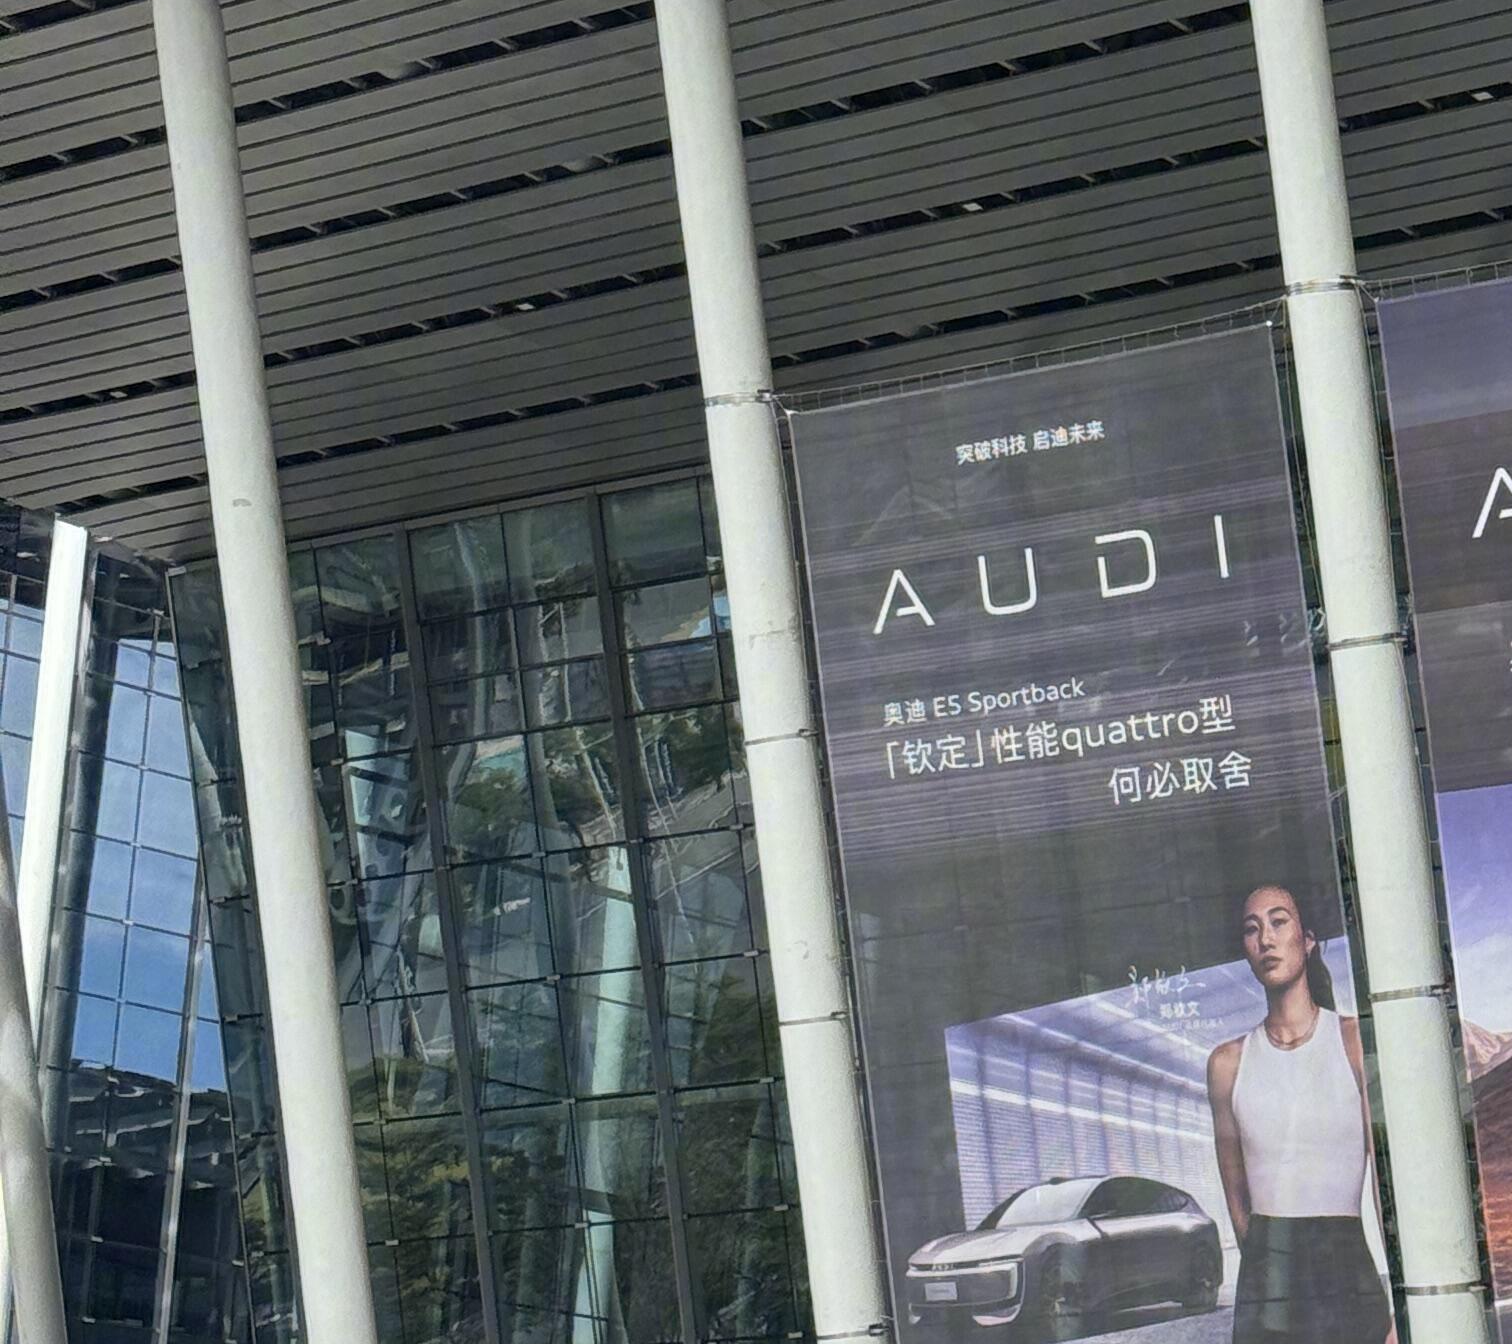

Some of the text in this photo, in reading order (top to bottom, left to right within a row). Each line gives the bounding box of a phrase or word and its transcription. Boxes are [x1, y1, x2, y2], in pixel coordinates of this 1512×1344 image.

[955, 420, 1105, 465] 突破科技 启迪未来
[873, 515, 1230, 635] AUDI
[884, 677, 1086, 727] 奥迪 E5 Sportback
[1108, 750, 1253, 805] 何必取舍
